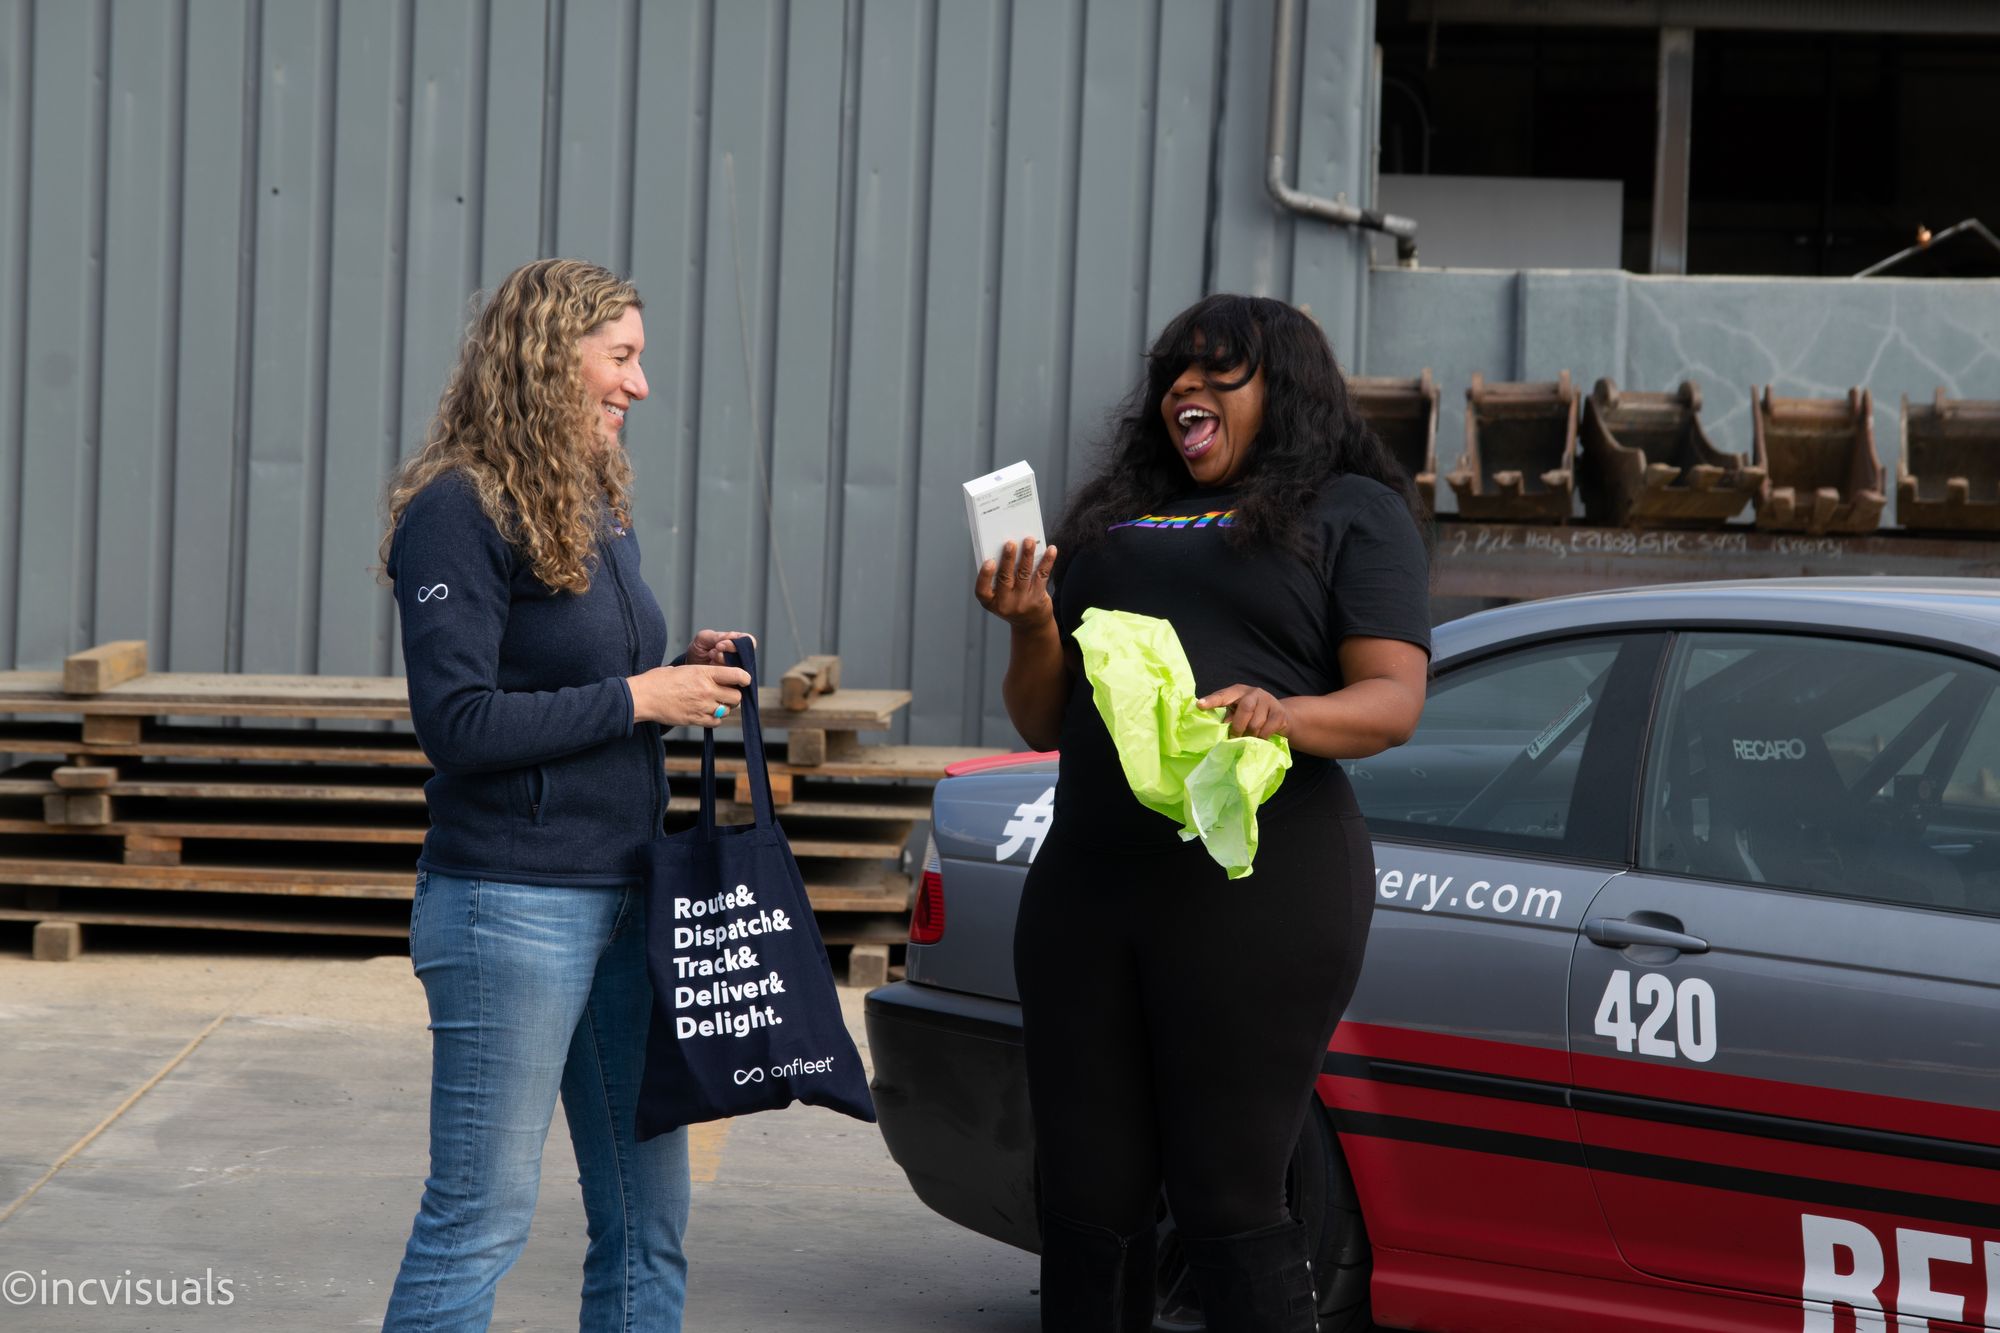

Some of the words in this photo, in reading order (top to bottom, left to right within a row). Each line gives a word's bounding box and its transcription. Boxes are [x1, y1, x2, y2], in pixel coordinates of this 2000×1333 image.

[1732, 738, 1806, 760] RECARO
[674, 884, 756, 920] Route&
[1375, 868, 1562, 919] ery.com
[674, 909, 792, 950] Dispatch&
[673, 946, 760, 979] Track&
[675, 971, 786, 1009] Deliver&
[676, 1005, 783, 1039] Delight.
[1594, 969, 1717, 1063] 420
[771, 1056, 834, 1079] onfleet
[1801, 1213, 2000, 1333] RE
